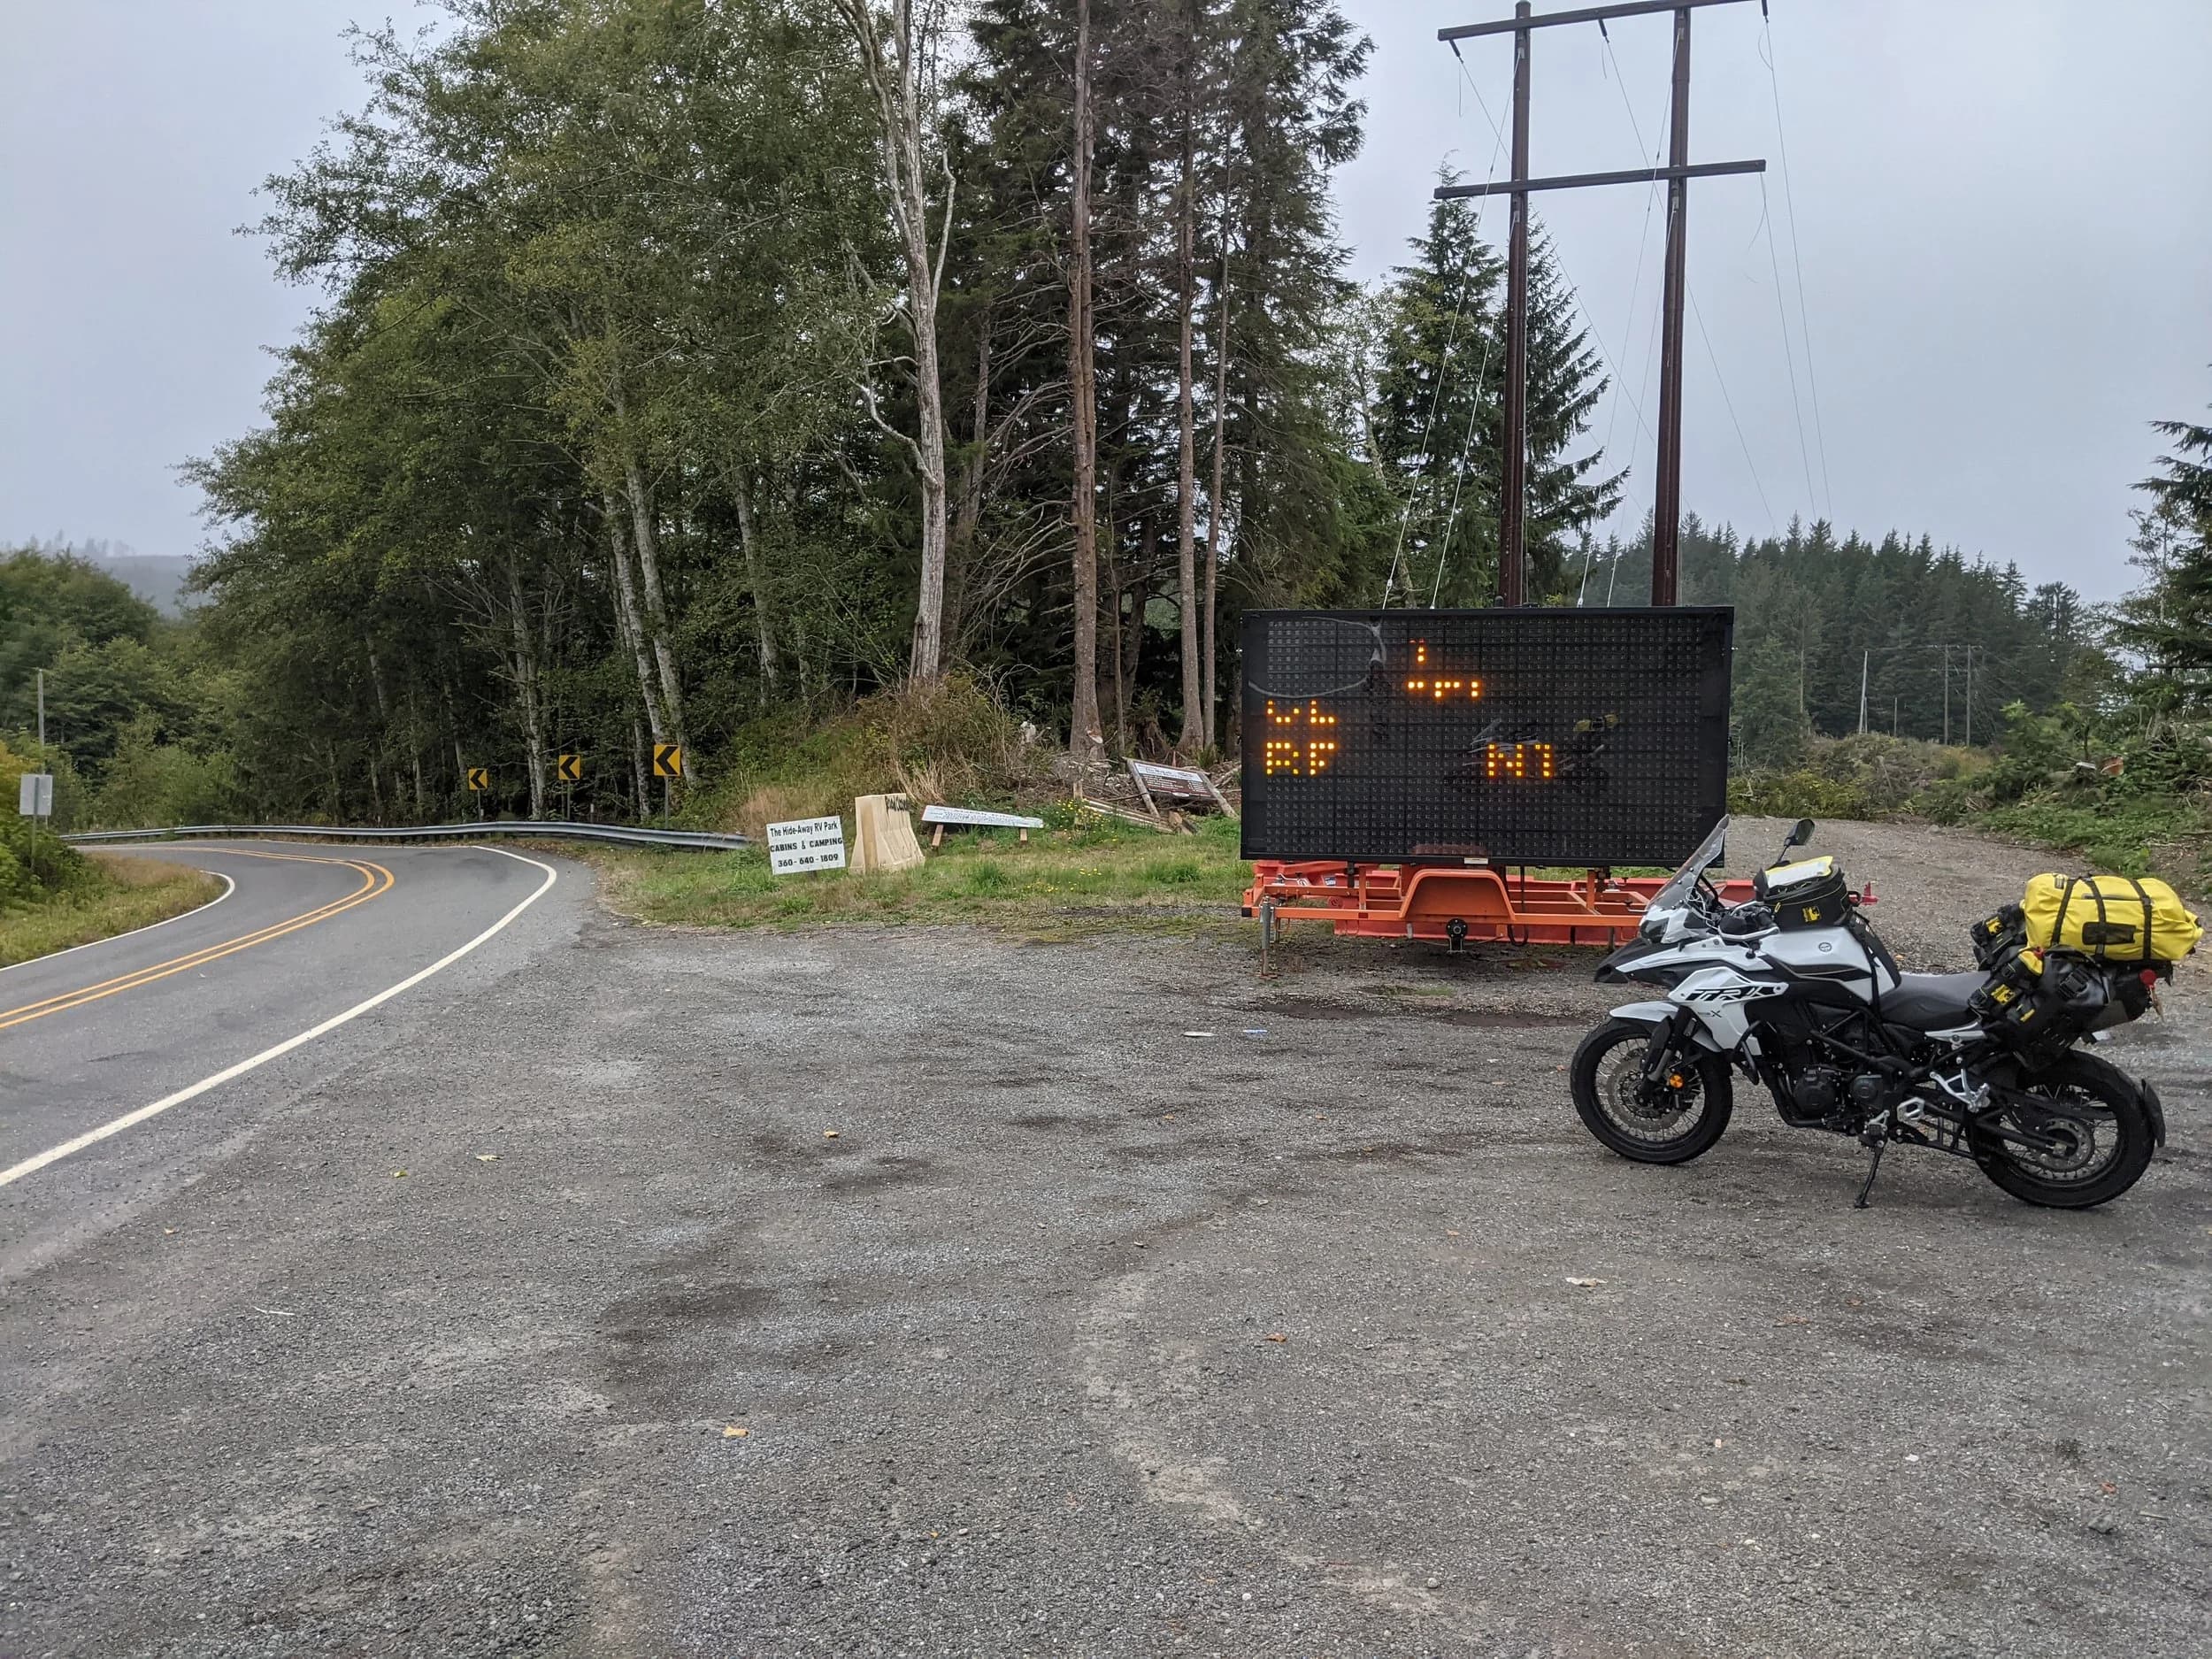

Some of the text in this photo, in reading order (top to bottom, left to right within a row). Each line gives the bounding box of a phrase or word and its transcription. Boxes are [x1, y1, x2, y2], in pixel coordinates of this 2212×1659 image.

[770, 827, 782, 838] The
[814, 822, 823, 832] RV
[824, 820, 838, 831] Park
[770, 842, 797, 852] CABINS
[809, 837, 843, 848] CAMPING
